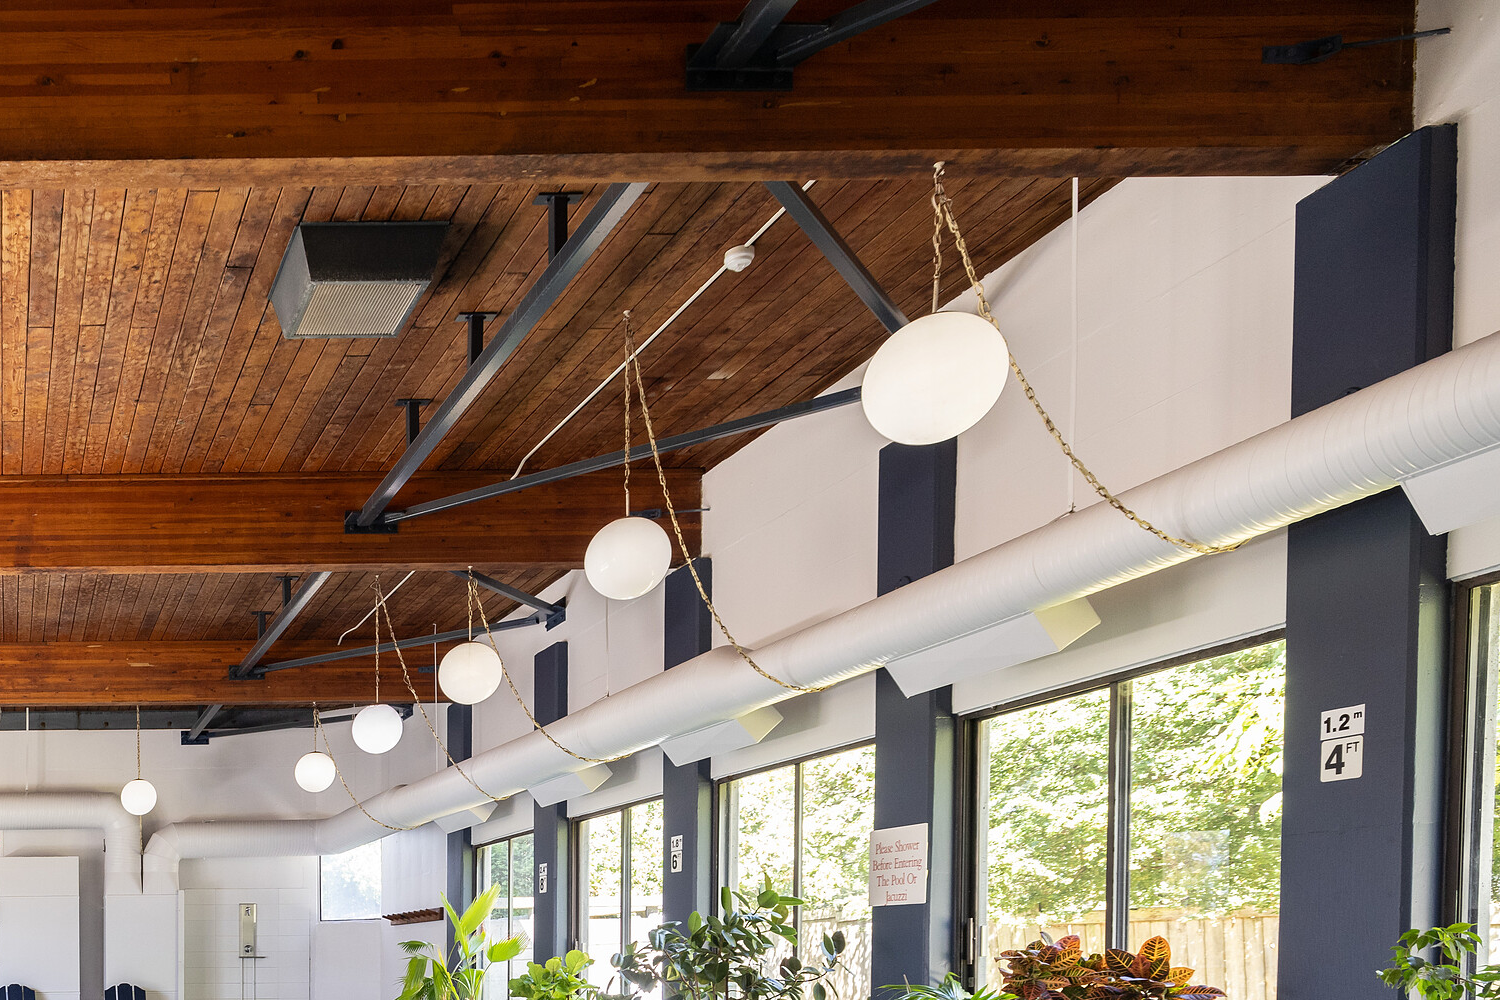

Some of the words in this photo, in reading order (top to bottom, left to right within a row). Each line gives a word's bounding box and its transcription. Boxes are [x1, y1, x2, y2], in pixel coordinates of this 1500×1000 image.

[1323, 713, 1350, 733] 1.2
[1324, 743, 1345, 775] 4
[1345, 741, 1360, 753] FT
[875, 841, 893, 855] Please
[894, 839, 919, 852] Shower
[672, 853, 678, 870] 6
[872, 857, 892, 871] Before
[894, 855, 922, 871] Entering
[876, 874, 889, 887] The
[891, 872, 905, 886] Pool
[906, 872, 917, 884] Or
[884, 889, 908, 905] Jacuzzi
